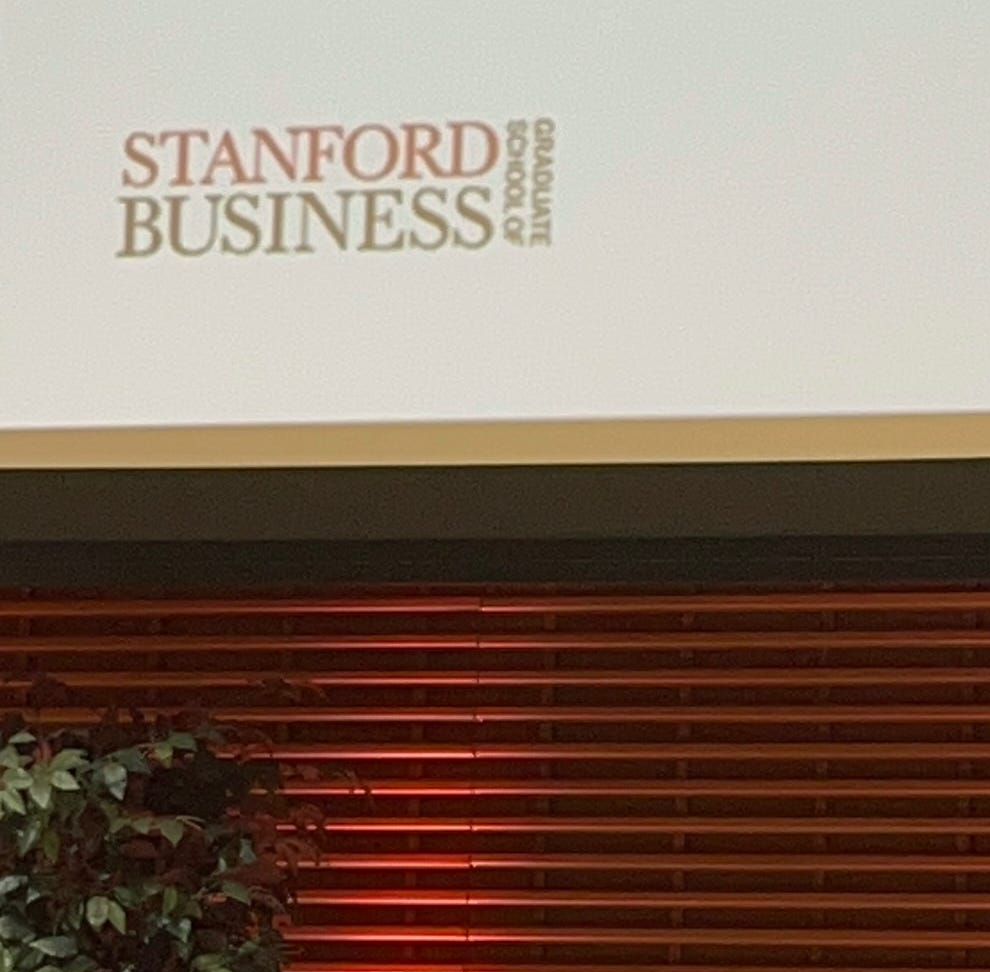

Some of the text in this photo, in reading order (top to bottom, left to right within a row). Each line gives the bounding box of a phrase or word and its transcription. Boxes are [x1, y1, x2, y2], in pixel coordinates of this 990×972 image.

[122, 120, 500, 188] STANFORD
[503, 119, 528, 247] SCHOOL OF
[530, 117, 555, 247] GRADUATE
[116, 185, 494, 258] BUSINESS
